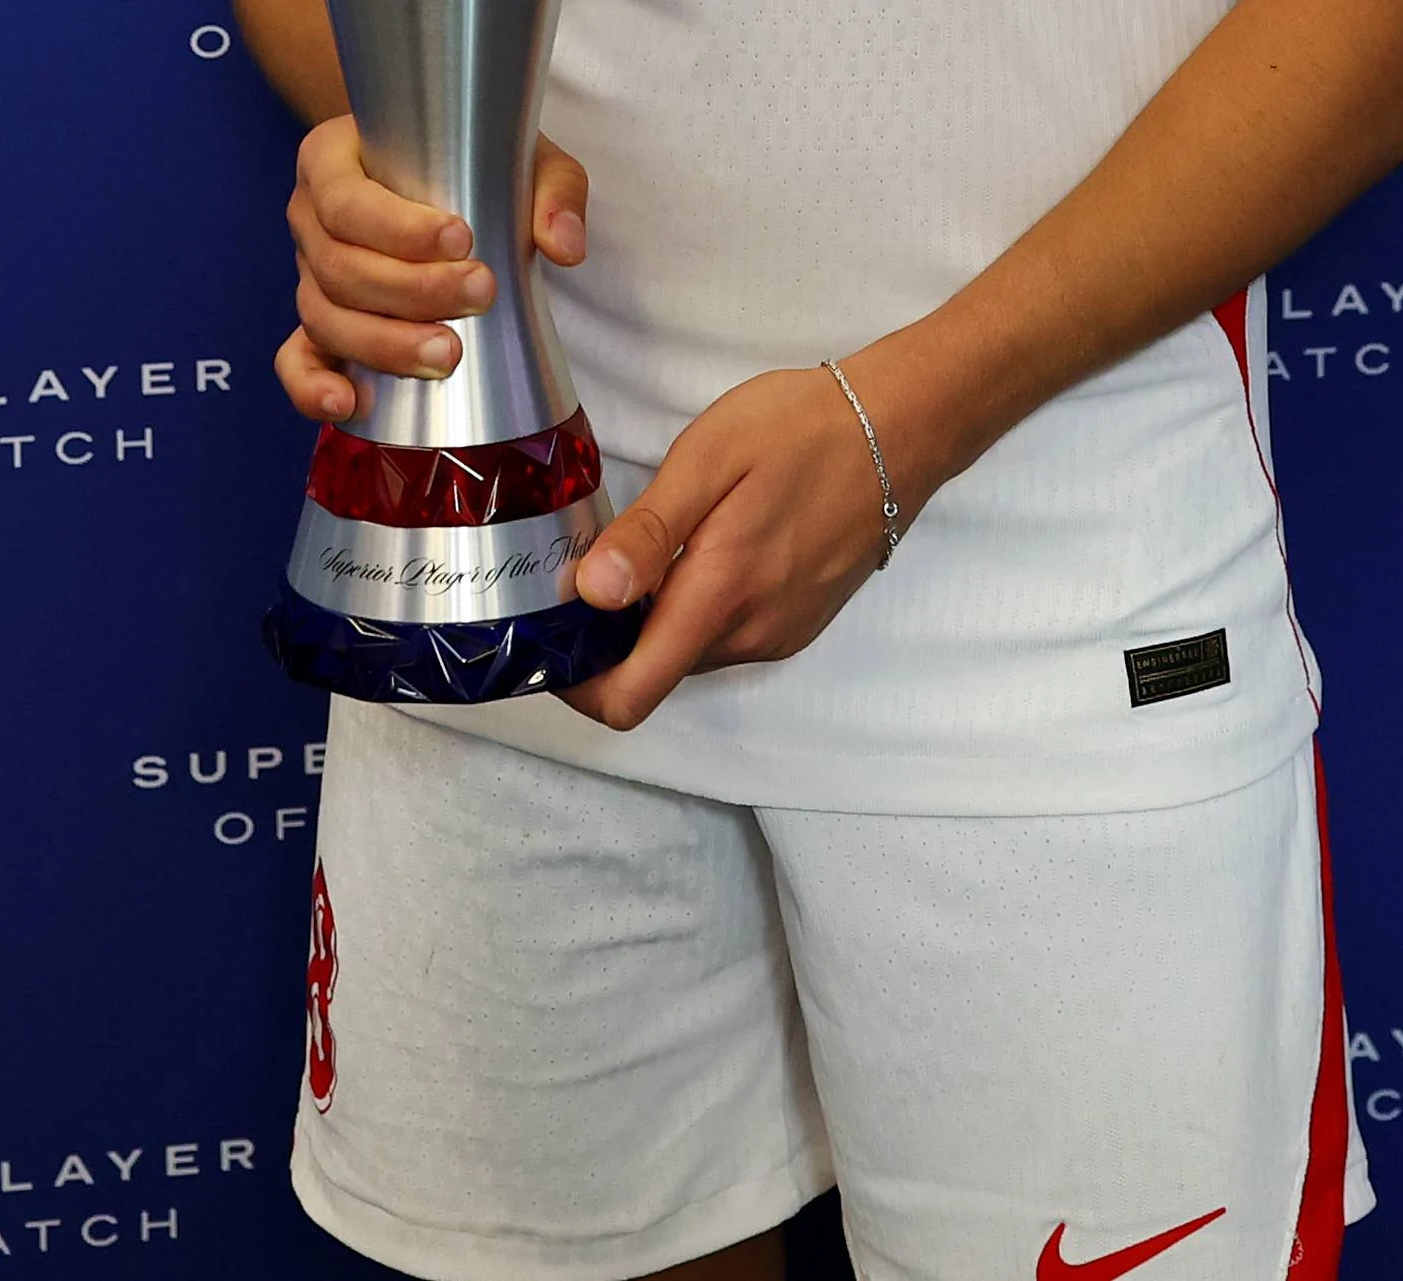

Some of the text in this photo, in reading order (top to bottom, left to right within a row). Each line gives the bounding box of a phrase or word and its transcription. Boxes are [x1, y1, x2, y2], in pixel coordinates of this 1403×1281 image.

[319, 547, 394, 583] Superior
[394, 556, 483, 596] Player
[477, 552, 521, 595] of
[508, 550, 541, 579] the
[214, 807, 307, 845] OF
